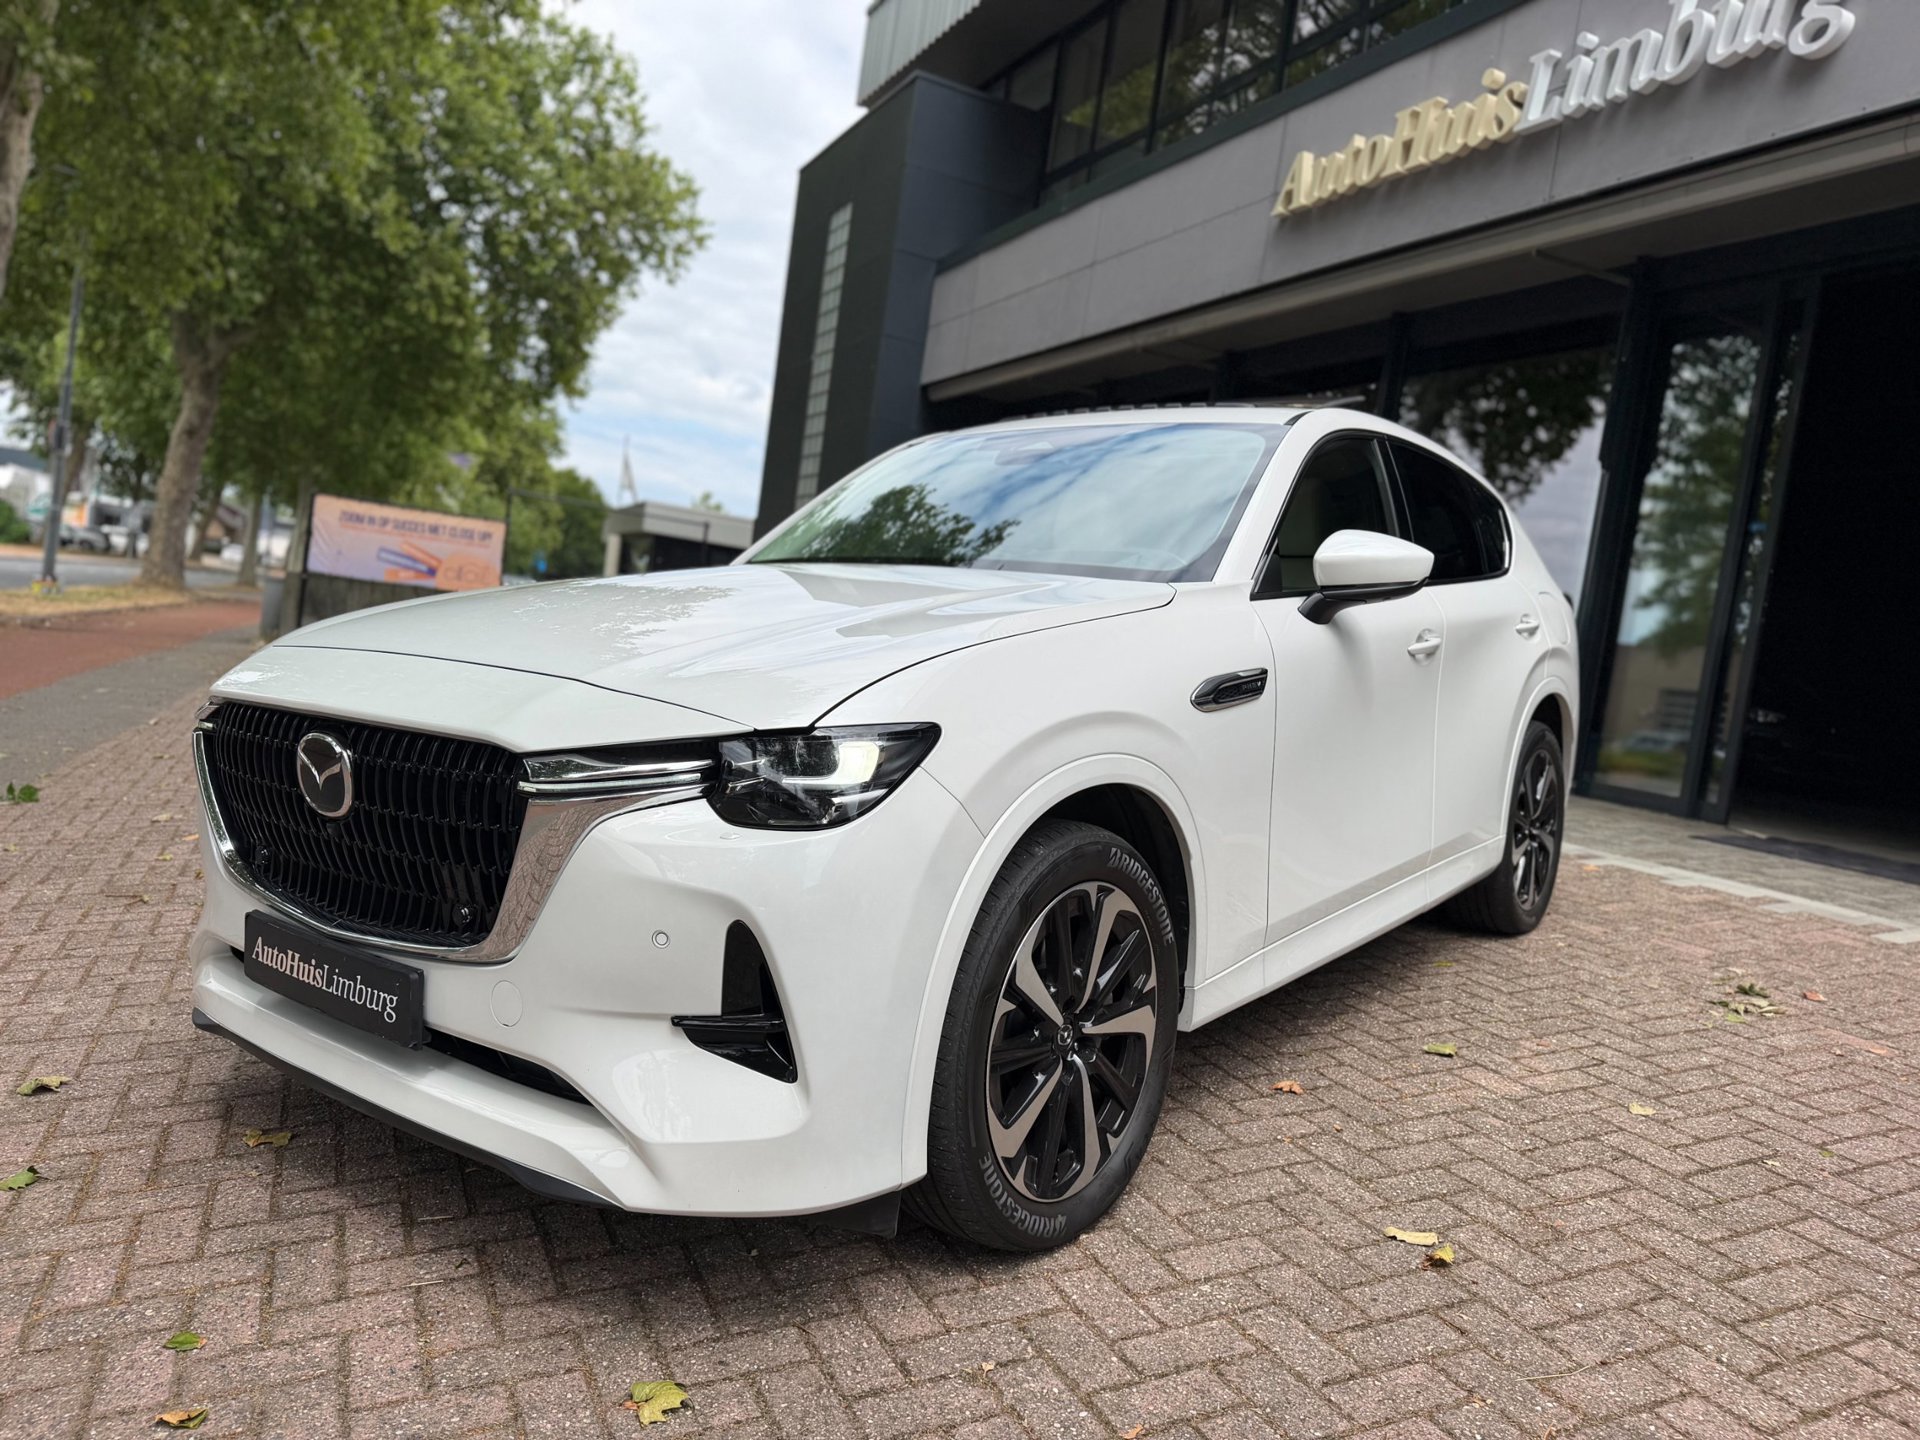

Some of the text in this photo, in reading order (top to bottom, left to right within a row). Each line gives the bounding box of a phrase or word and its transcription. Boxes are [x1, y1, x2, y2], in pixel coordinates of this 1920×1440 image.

[1107, 847, 1176, 947] BRIDGESTONE
[252, 936, 398, 1023] AutoHuisLimburg
[979, 1151, 1067, 1238] BRIDGESTONE
